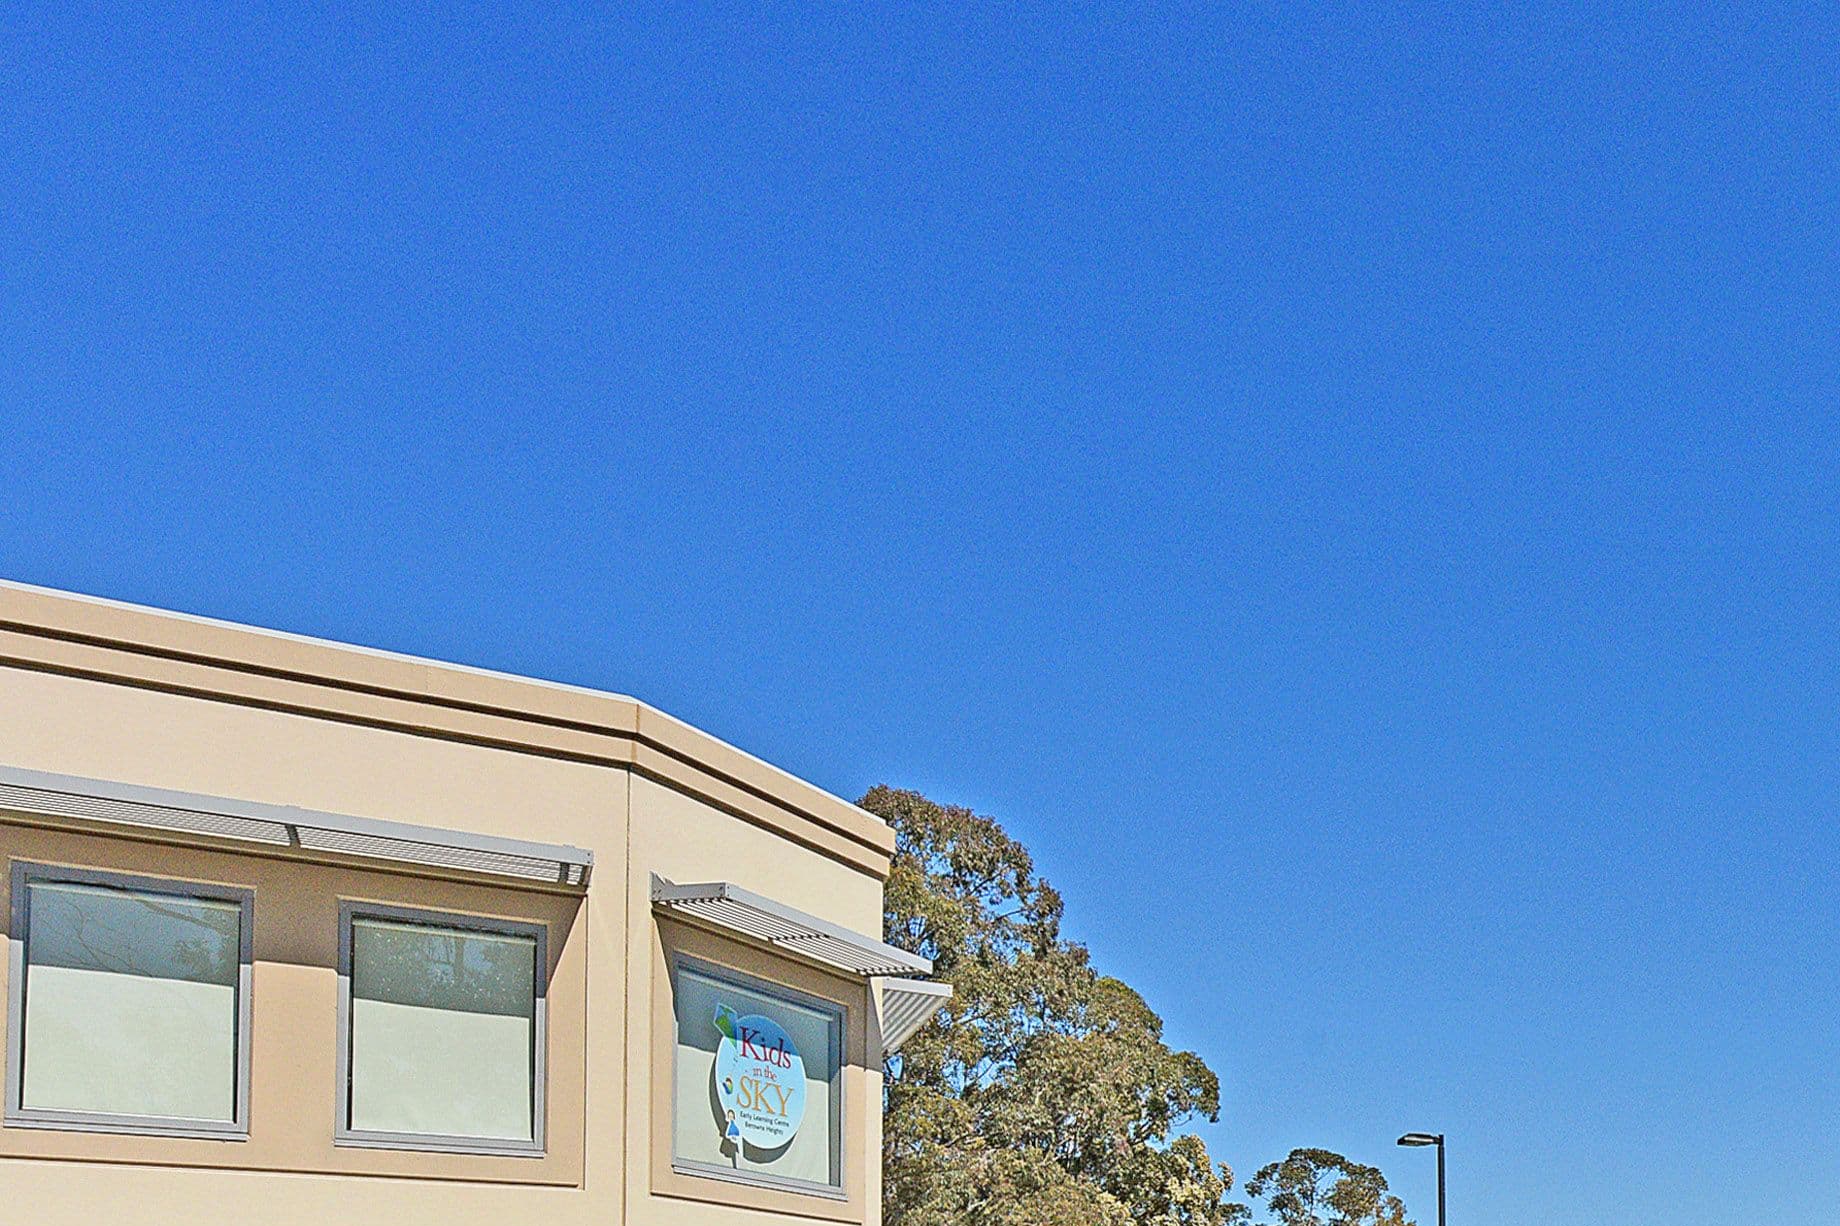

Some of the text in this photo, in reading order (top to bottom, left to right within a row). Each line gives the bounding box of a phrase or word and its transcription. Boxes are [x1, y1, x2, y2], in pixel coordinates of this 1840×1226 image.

[739, 1026, 791, 1070] Kids
[752, 1065, 777, 1081] in the
[736, 1076, 795, 1117] SKY
